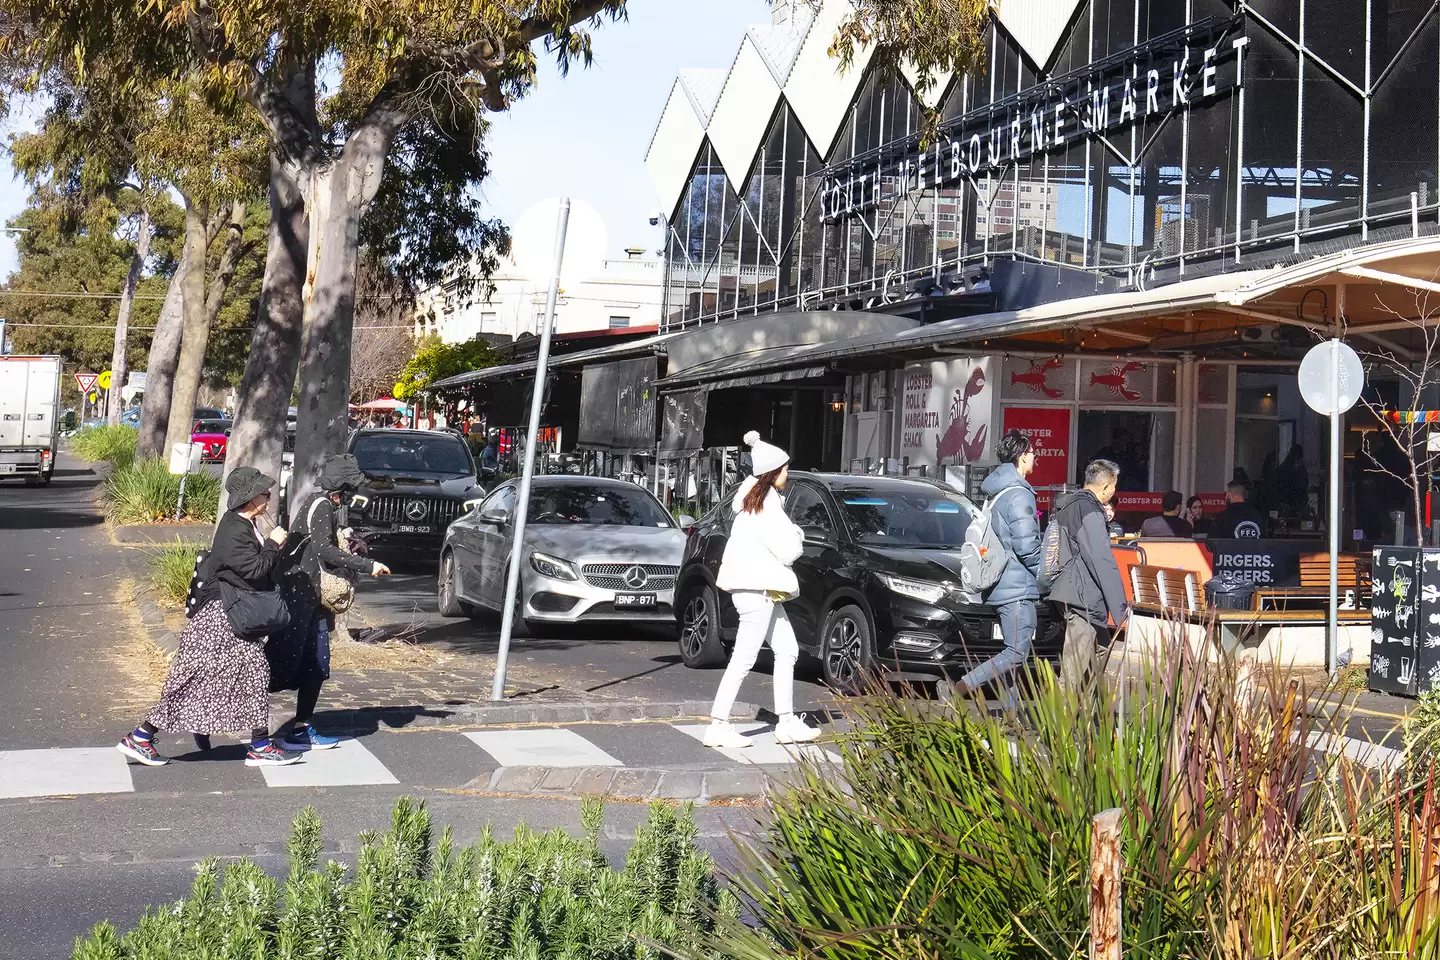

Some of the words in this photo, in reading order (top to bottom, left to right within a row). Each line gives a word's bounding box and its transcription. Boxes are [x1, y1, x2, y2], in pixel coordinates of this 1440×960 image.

[899, 103, 1065, 197] MELBOURNE
[1092, 37, 1248, 132] MARKET
[906, 373, 933, 391] LOBSTER
[905, 394, 920, 410] ROLL
[921, 393, 927, 408] &
[904, 411, 940, 429] MARGARITA
[903, 432, 923, 449] SHACK
[1035, 438, 1043, 447] &
